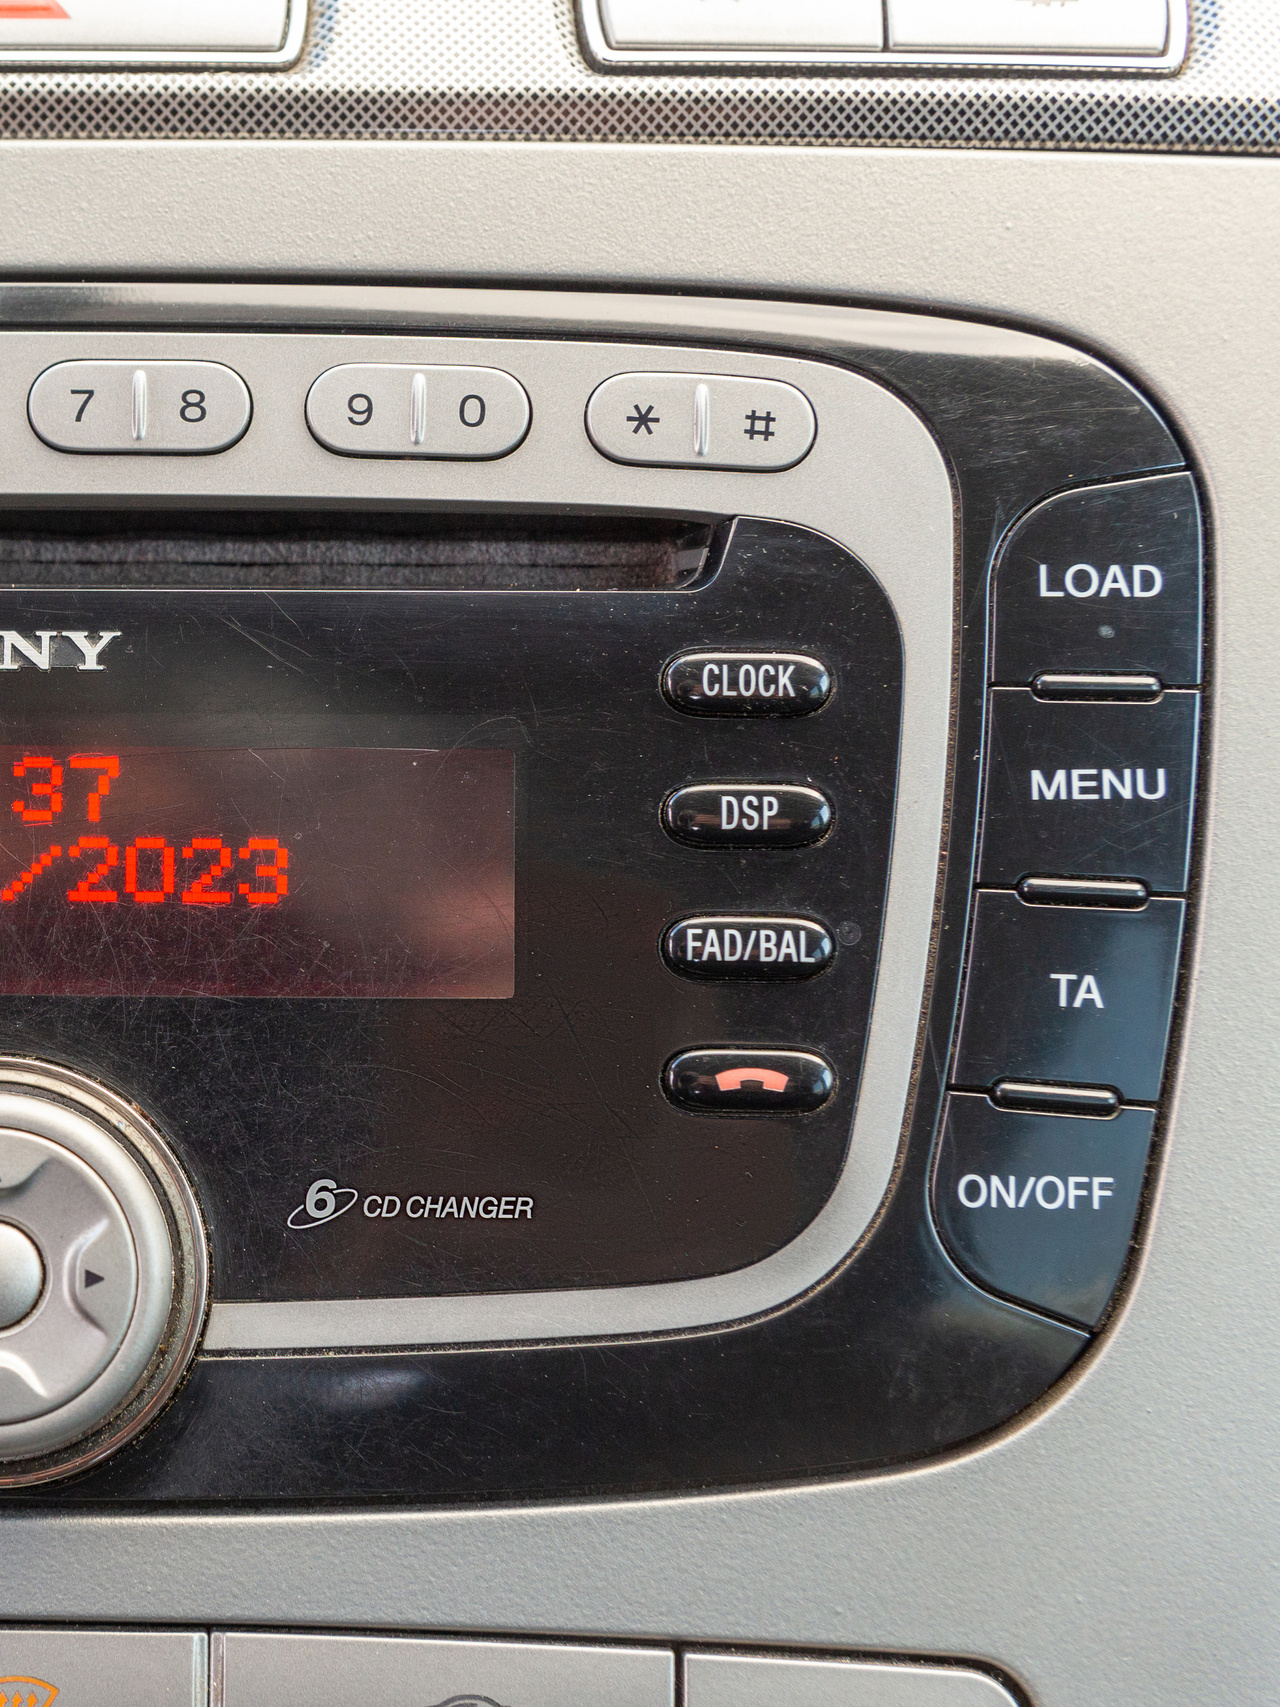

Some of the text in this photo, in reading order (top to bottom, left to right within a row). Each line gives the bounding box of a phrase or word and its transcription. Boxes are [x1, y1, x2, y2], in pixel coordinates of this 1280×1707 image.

[69, 389, 208, 423] 7 8
[346, 393, 487, 428] 9 0
[1038, 563, 1164, 599] LOAD
[701, 663, 797, 698] CLOCK
[1030, 767, 1167, 801] MENU
[720, 795, 780, 831] DSP
[685, 927, 817, 963] FAD/BAL
[1048, 972, 1106, 1010] TA
[305, 1178, 534, 1219] 6 CD CHANGER
[956, 1173, 1116, 1210] ON/OFF
